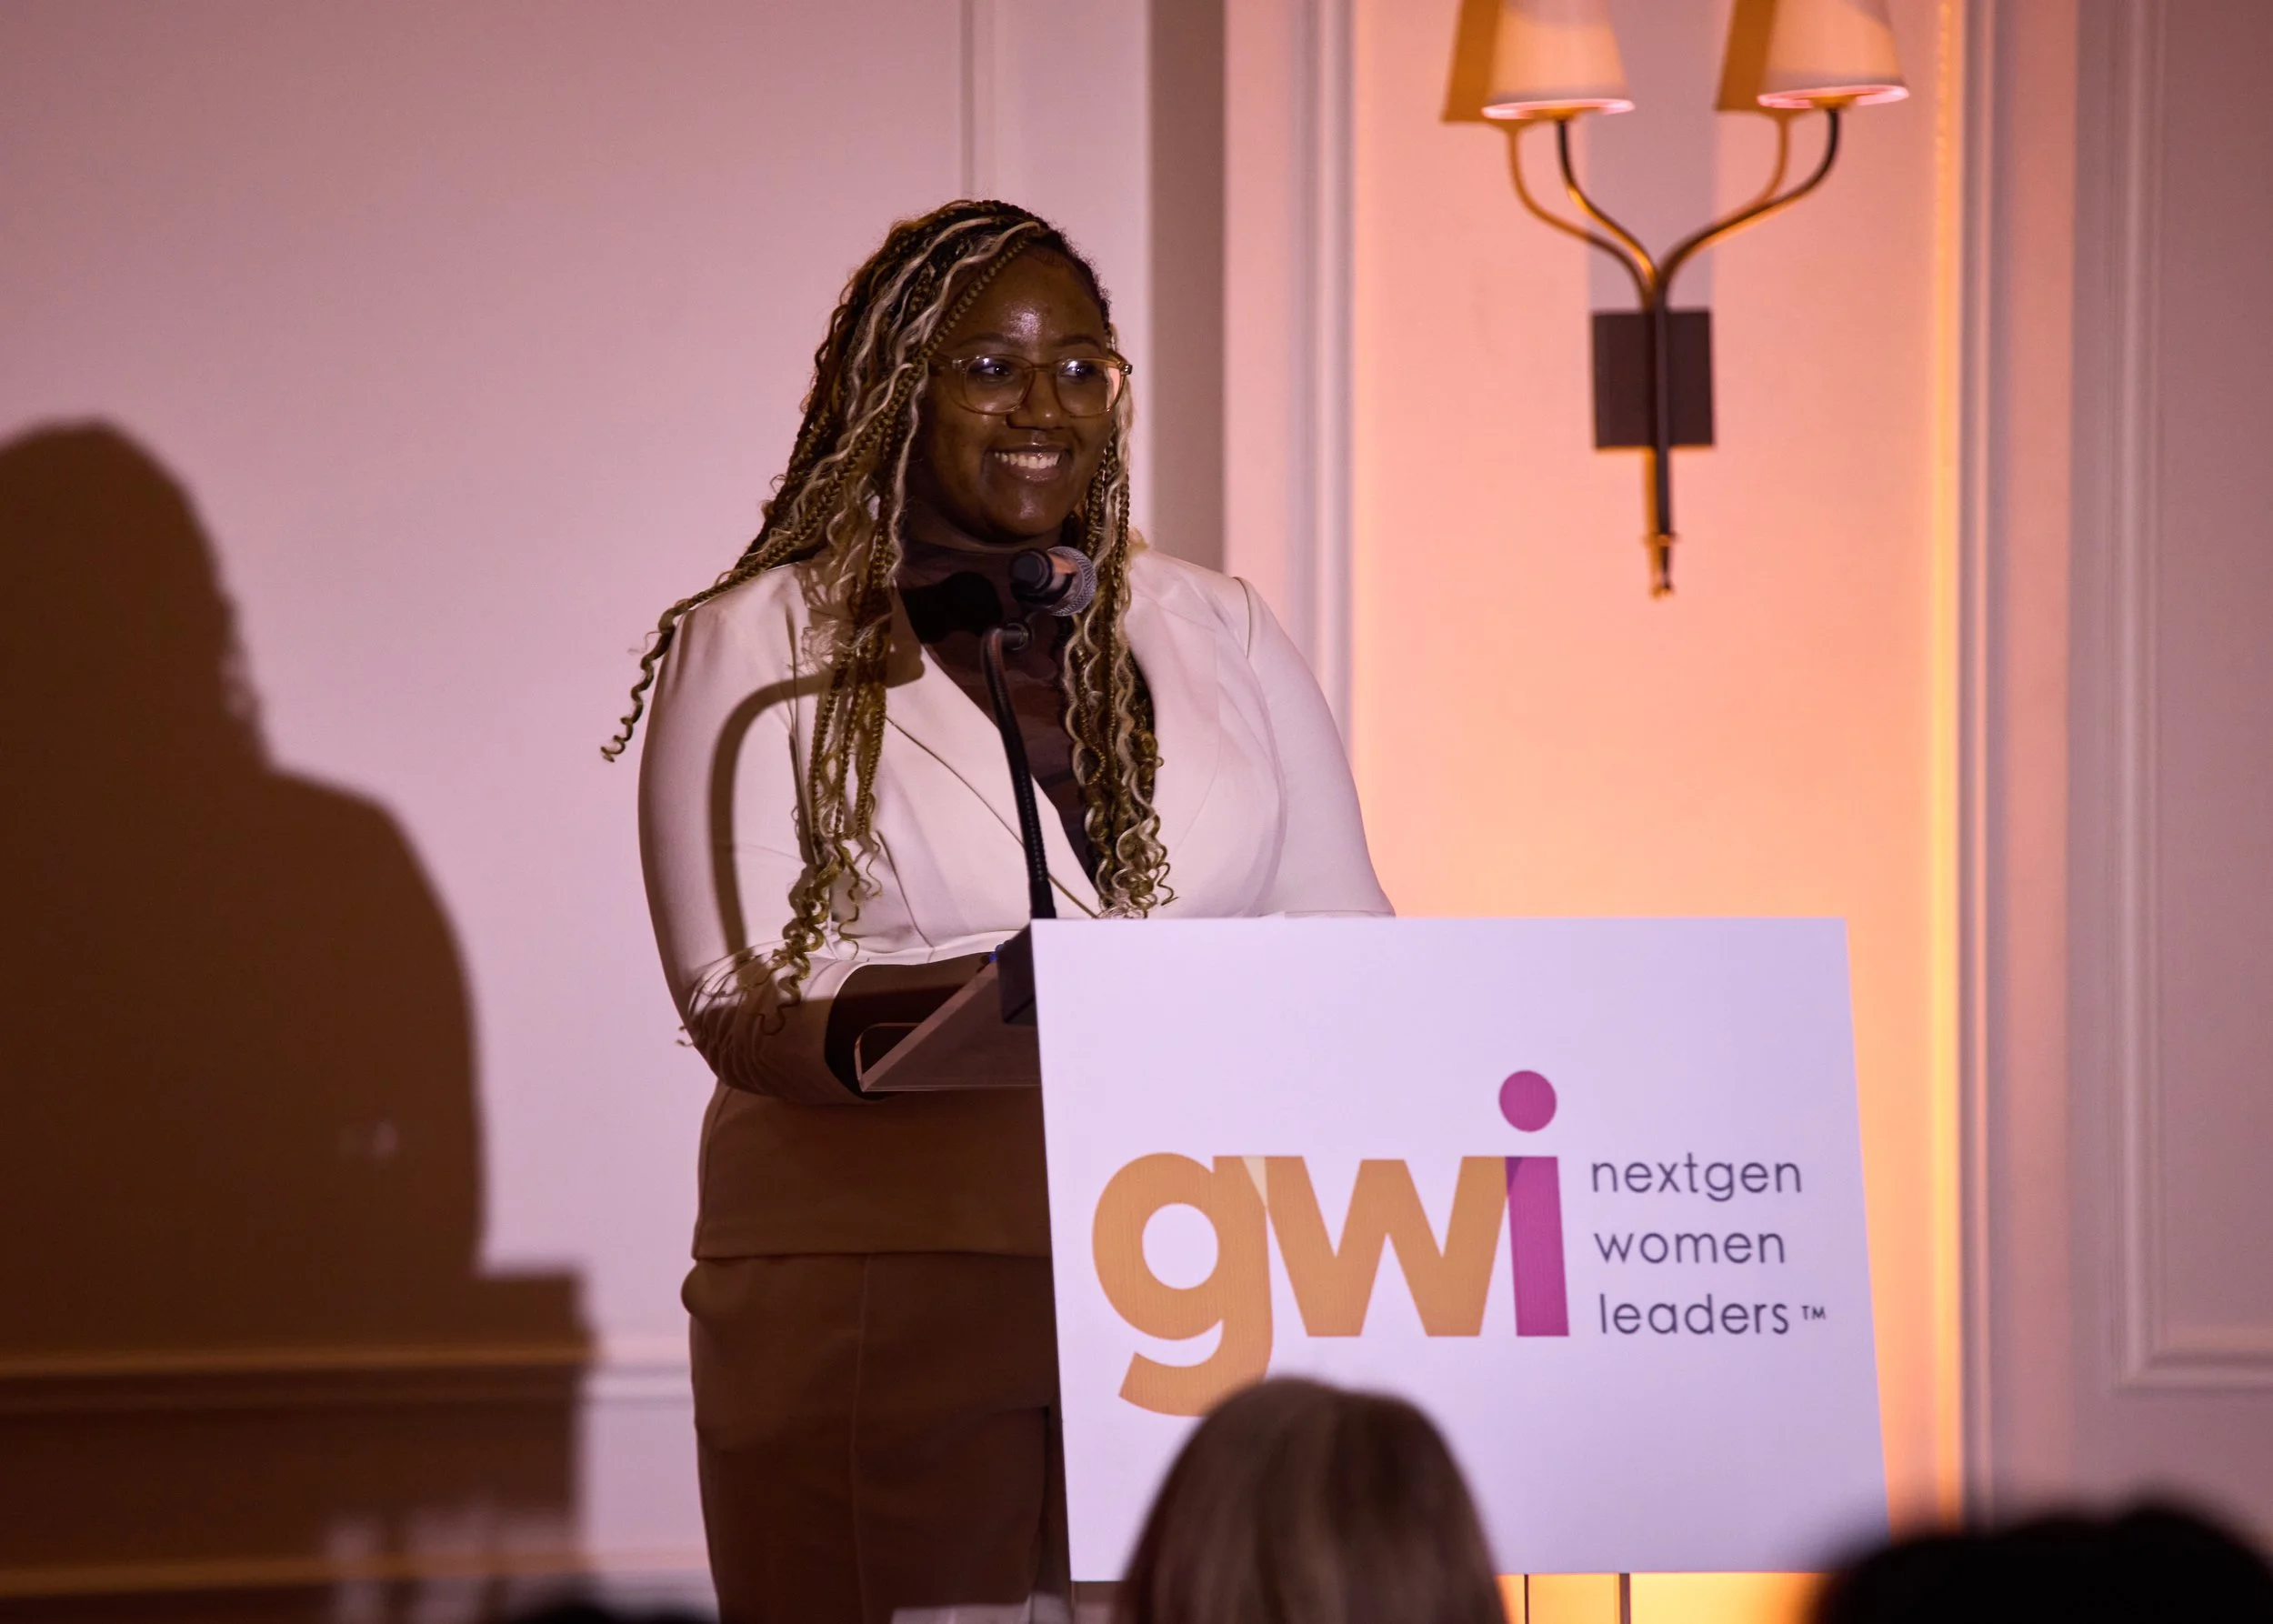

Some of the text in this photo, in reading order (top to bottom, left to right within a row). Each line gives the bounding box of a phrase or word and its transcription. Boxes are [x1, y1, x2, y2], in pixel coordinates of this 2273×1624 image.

[1591, 1152, 1802, 1202] nextgen
[1092, 1070, 1569, 1417] gwi
[1594, 1233, 1785, 1264] women
